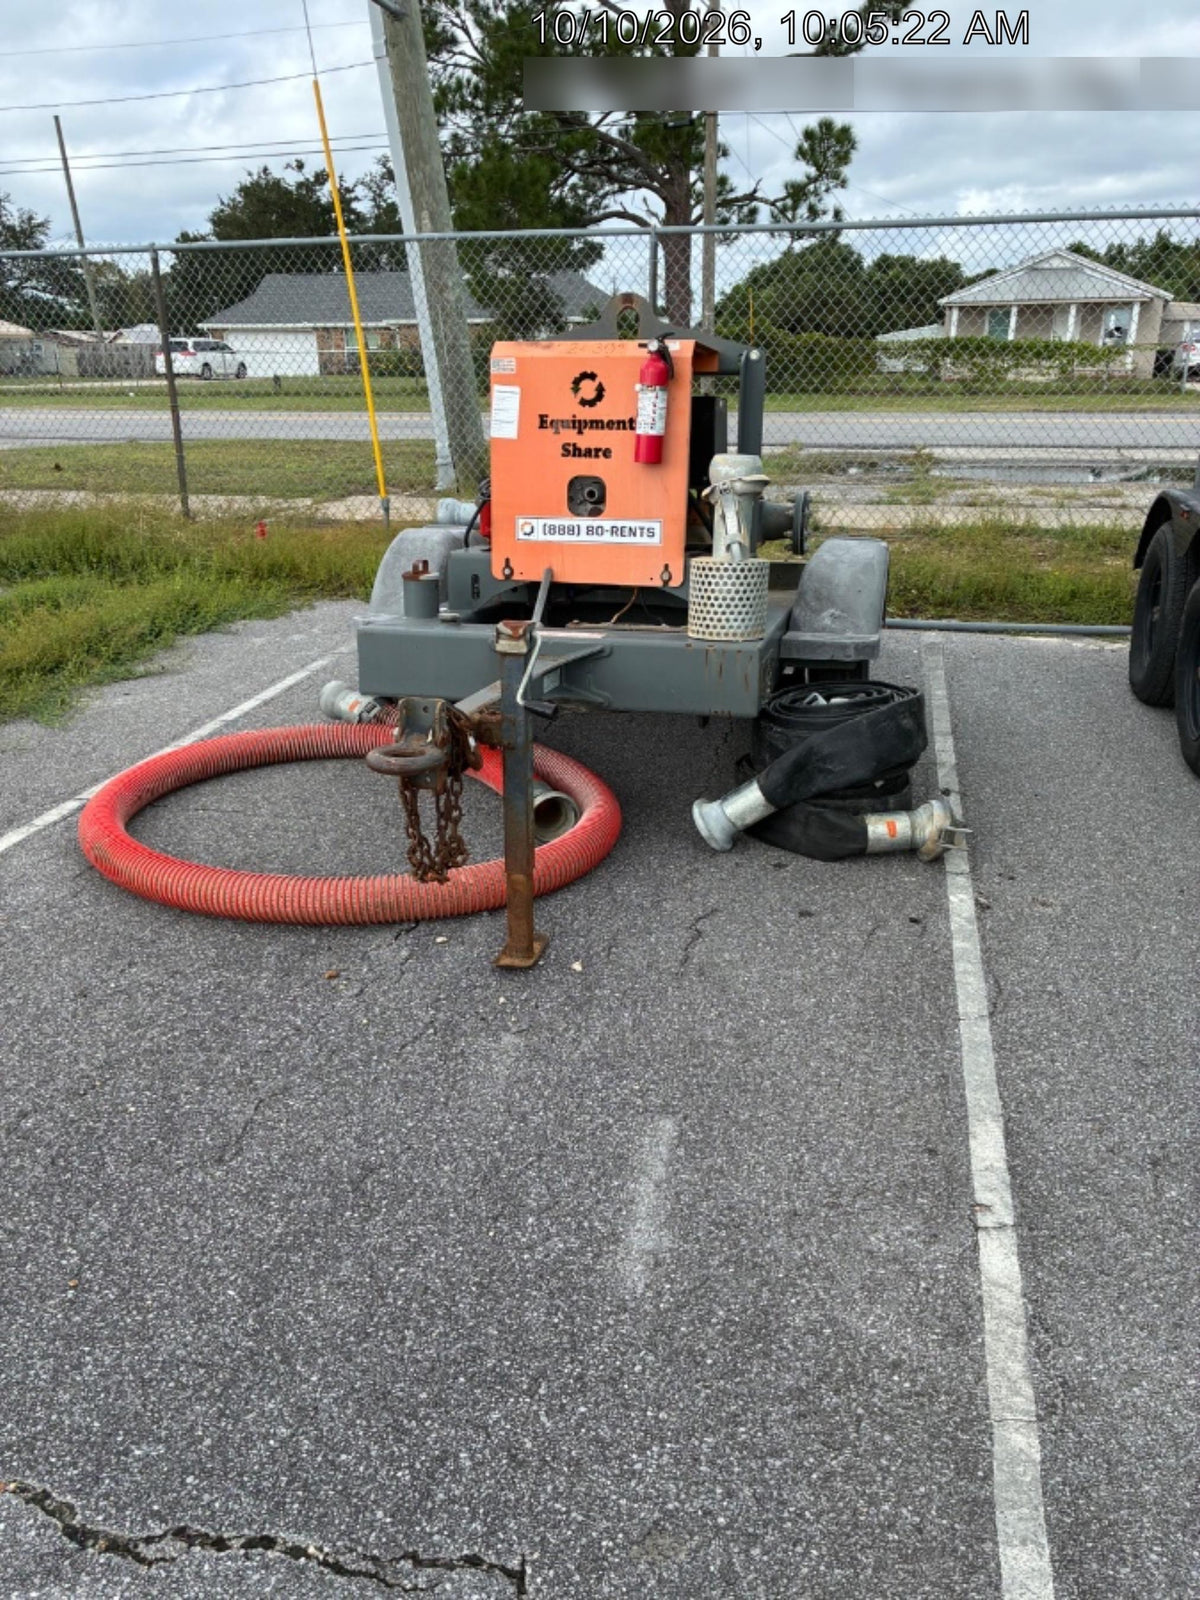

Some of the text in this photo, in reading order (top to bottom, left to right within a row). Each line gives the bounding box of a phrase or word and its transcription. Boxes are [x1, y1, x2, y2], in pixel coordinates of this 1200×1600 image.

[538, 414, 635, 434] Equipment
[561, 442, 612, 459] Share
[543, 523, 655, 538] (888) 80-RENTS
